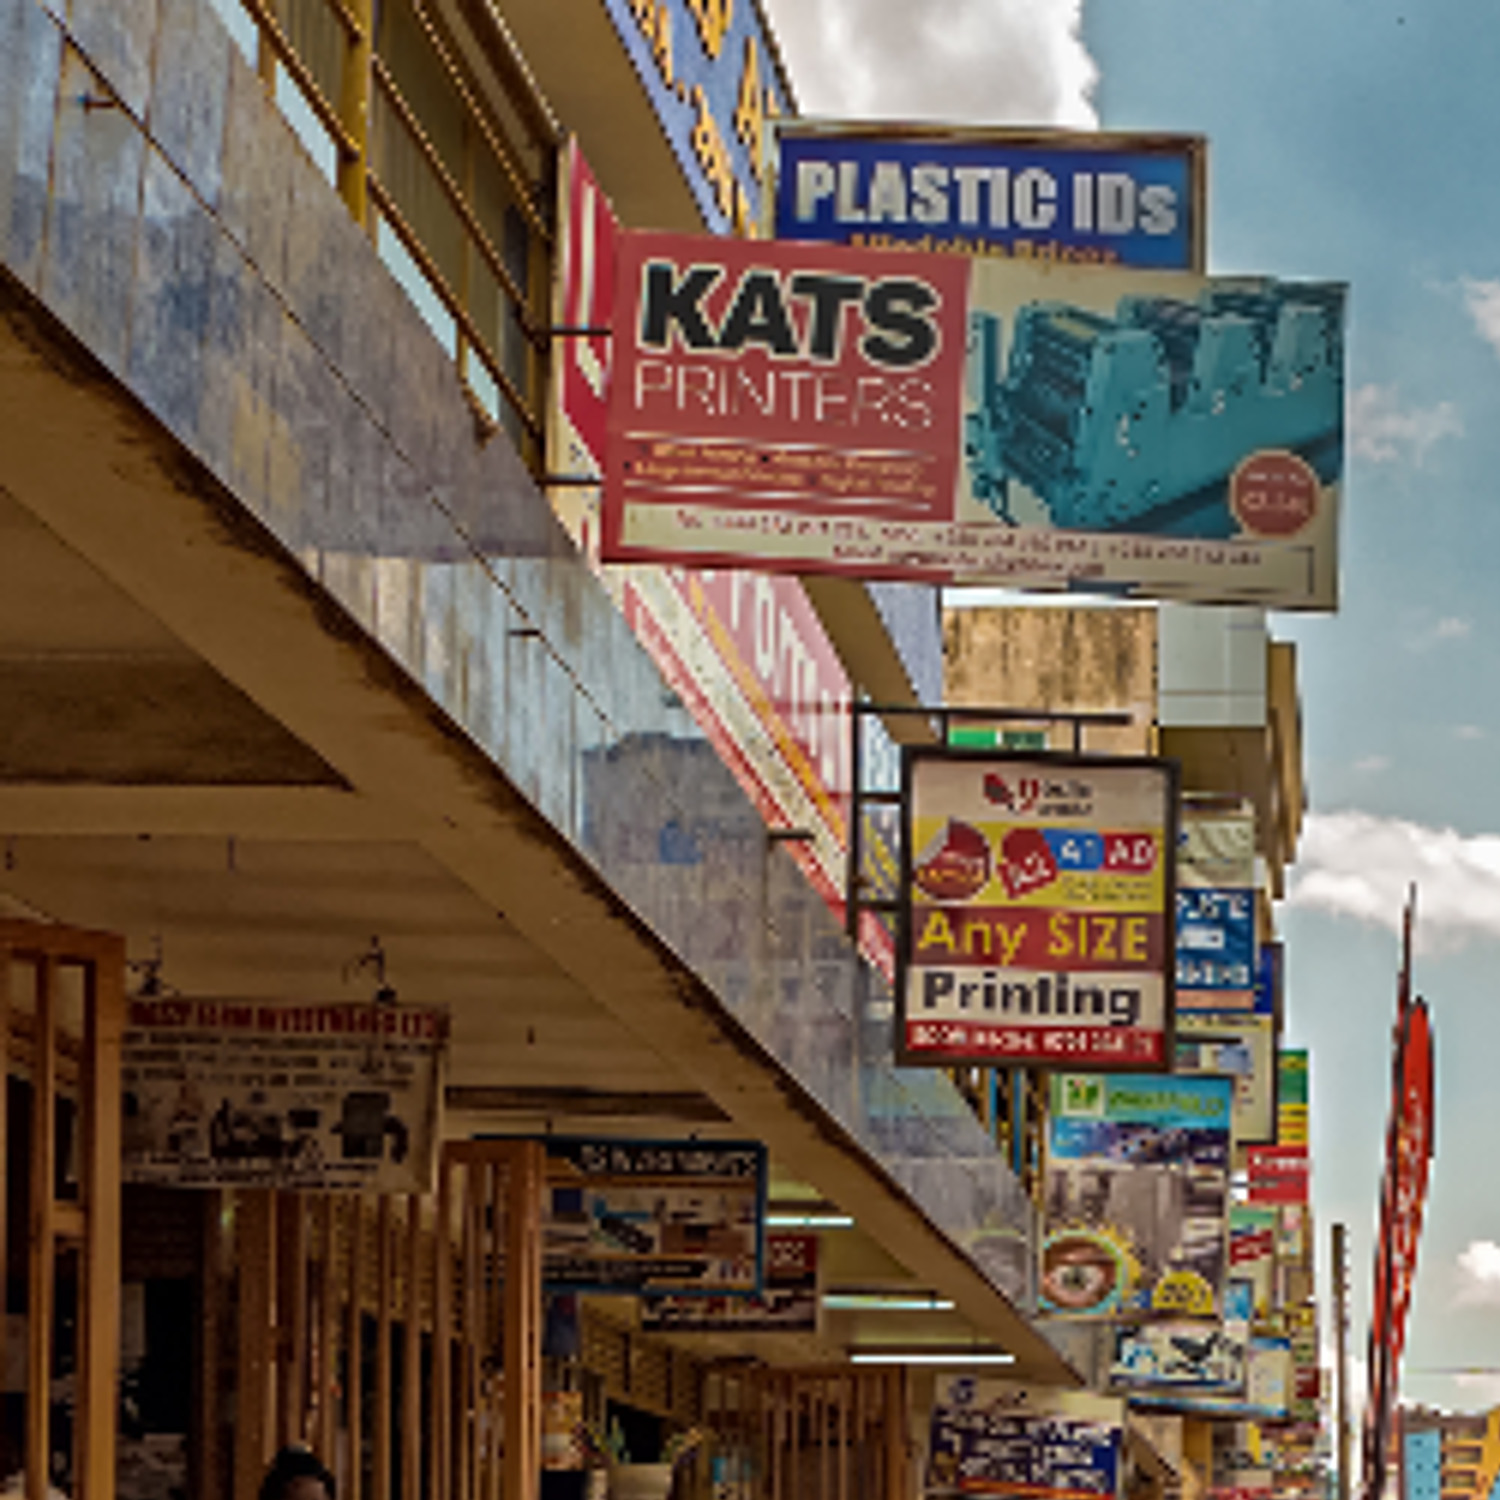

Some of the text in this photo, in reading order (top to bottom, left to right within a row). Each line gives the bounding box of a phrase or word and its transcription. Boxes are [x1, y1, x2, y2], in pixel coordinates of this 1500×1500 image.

[795, 160, 1178, 236] PLASTIC IDs
[638, 259, 942, 370] KATS
[634, 361, 933, 428] PRINTERS
[917, 910, 1148, 966] Any SIZE
[923, 971, 1141, 1026] Printing
